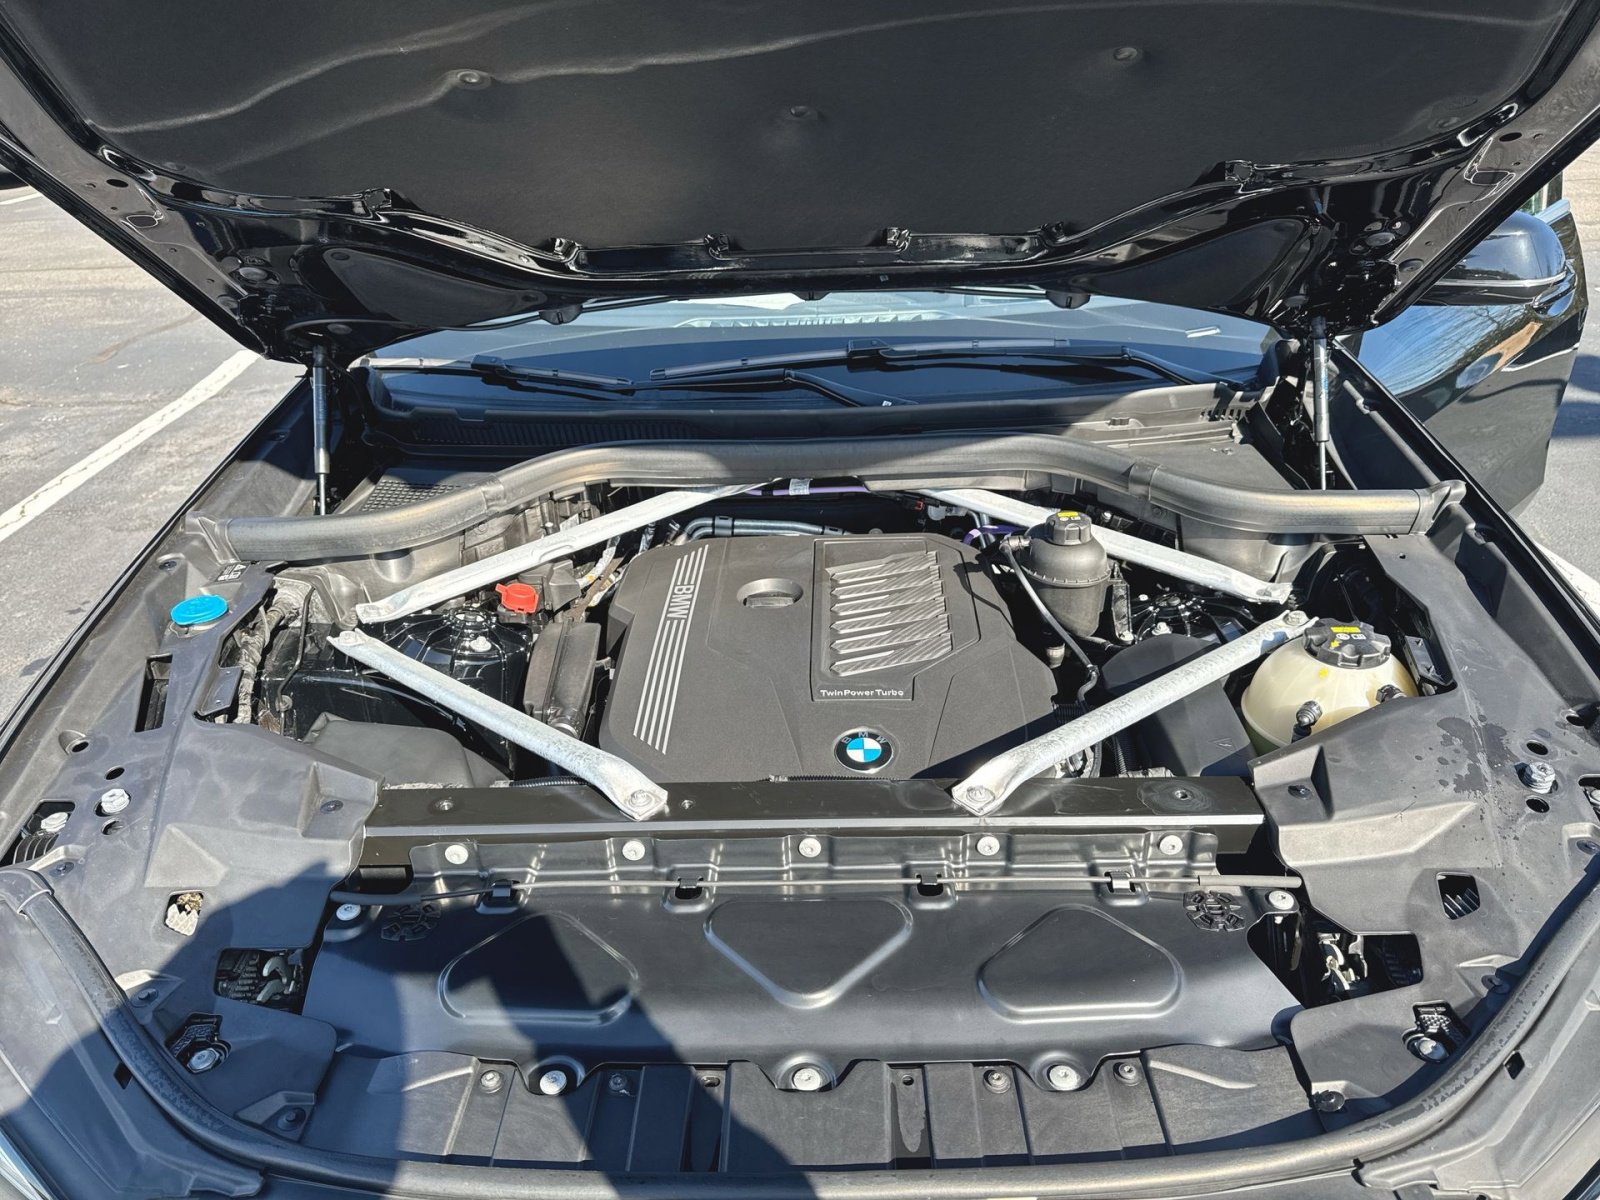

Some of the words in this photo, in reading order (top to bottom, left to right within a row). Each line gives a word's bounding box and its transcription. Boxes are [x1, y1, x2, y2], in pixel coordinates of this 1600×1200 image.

[666, 584, 695, 619] BMW
[820, 688, 874, 697] TwinPower
[875, 688, 904, 697] Turbo
[841, 731, 888, 744] BMW
